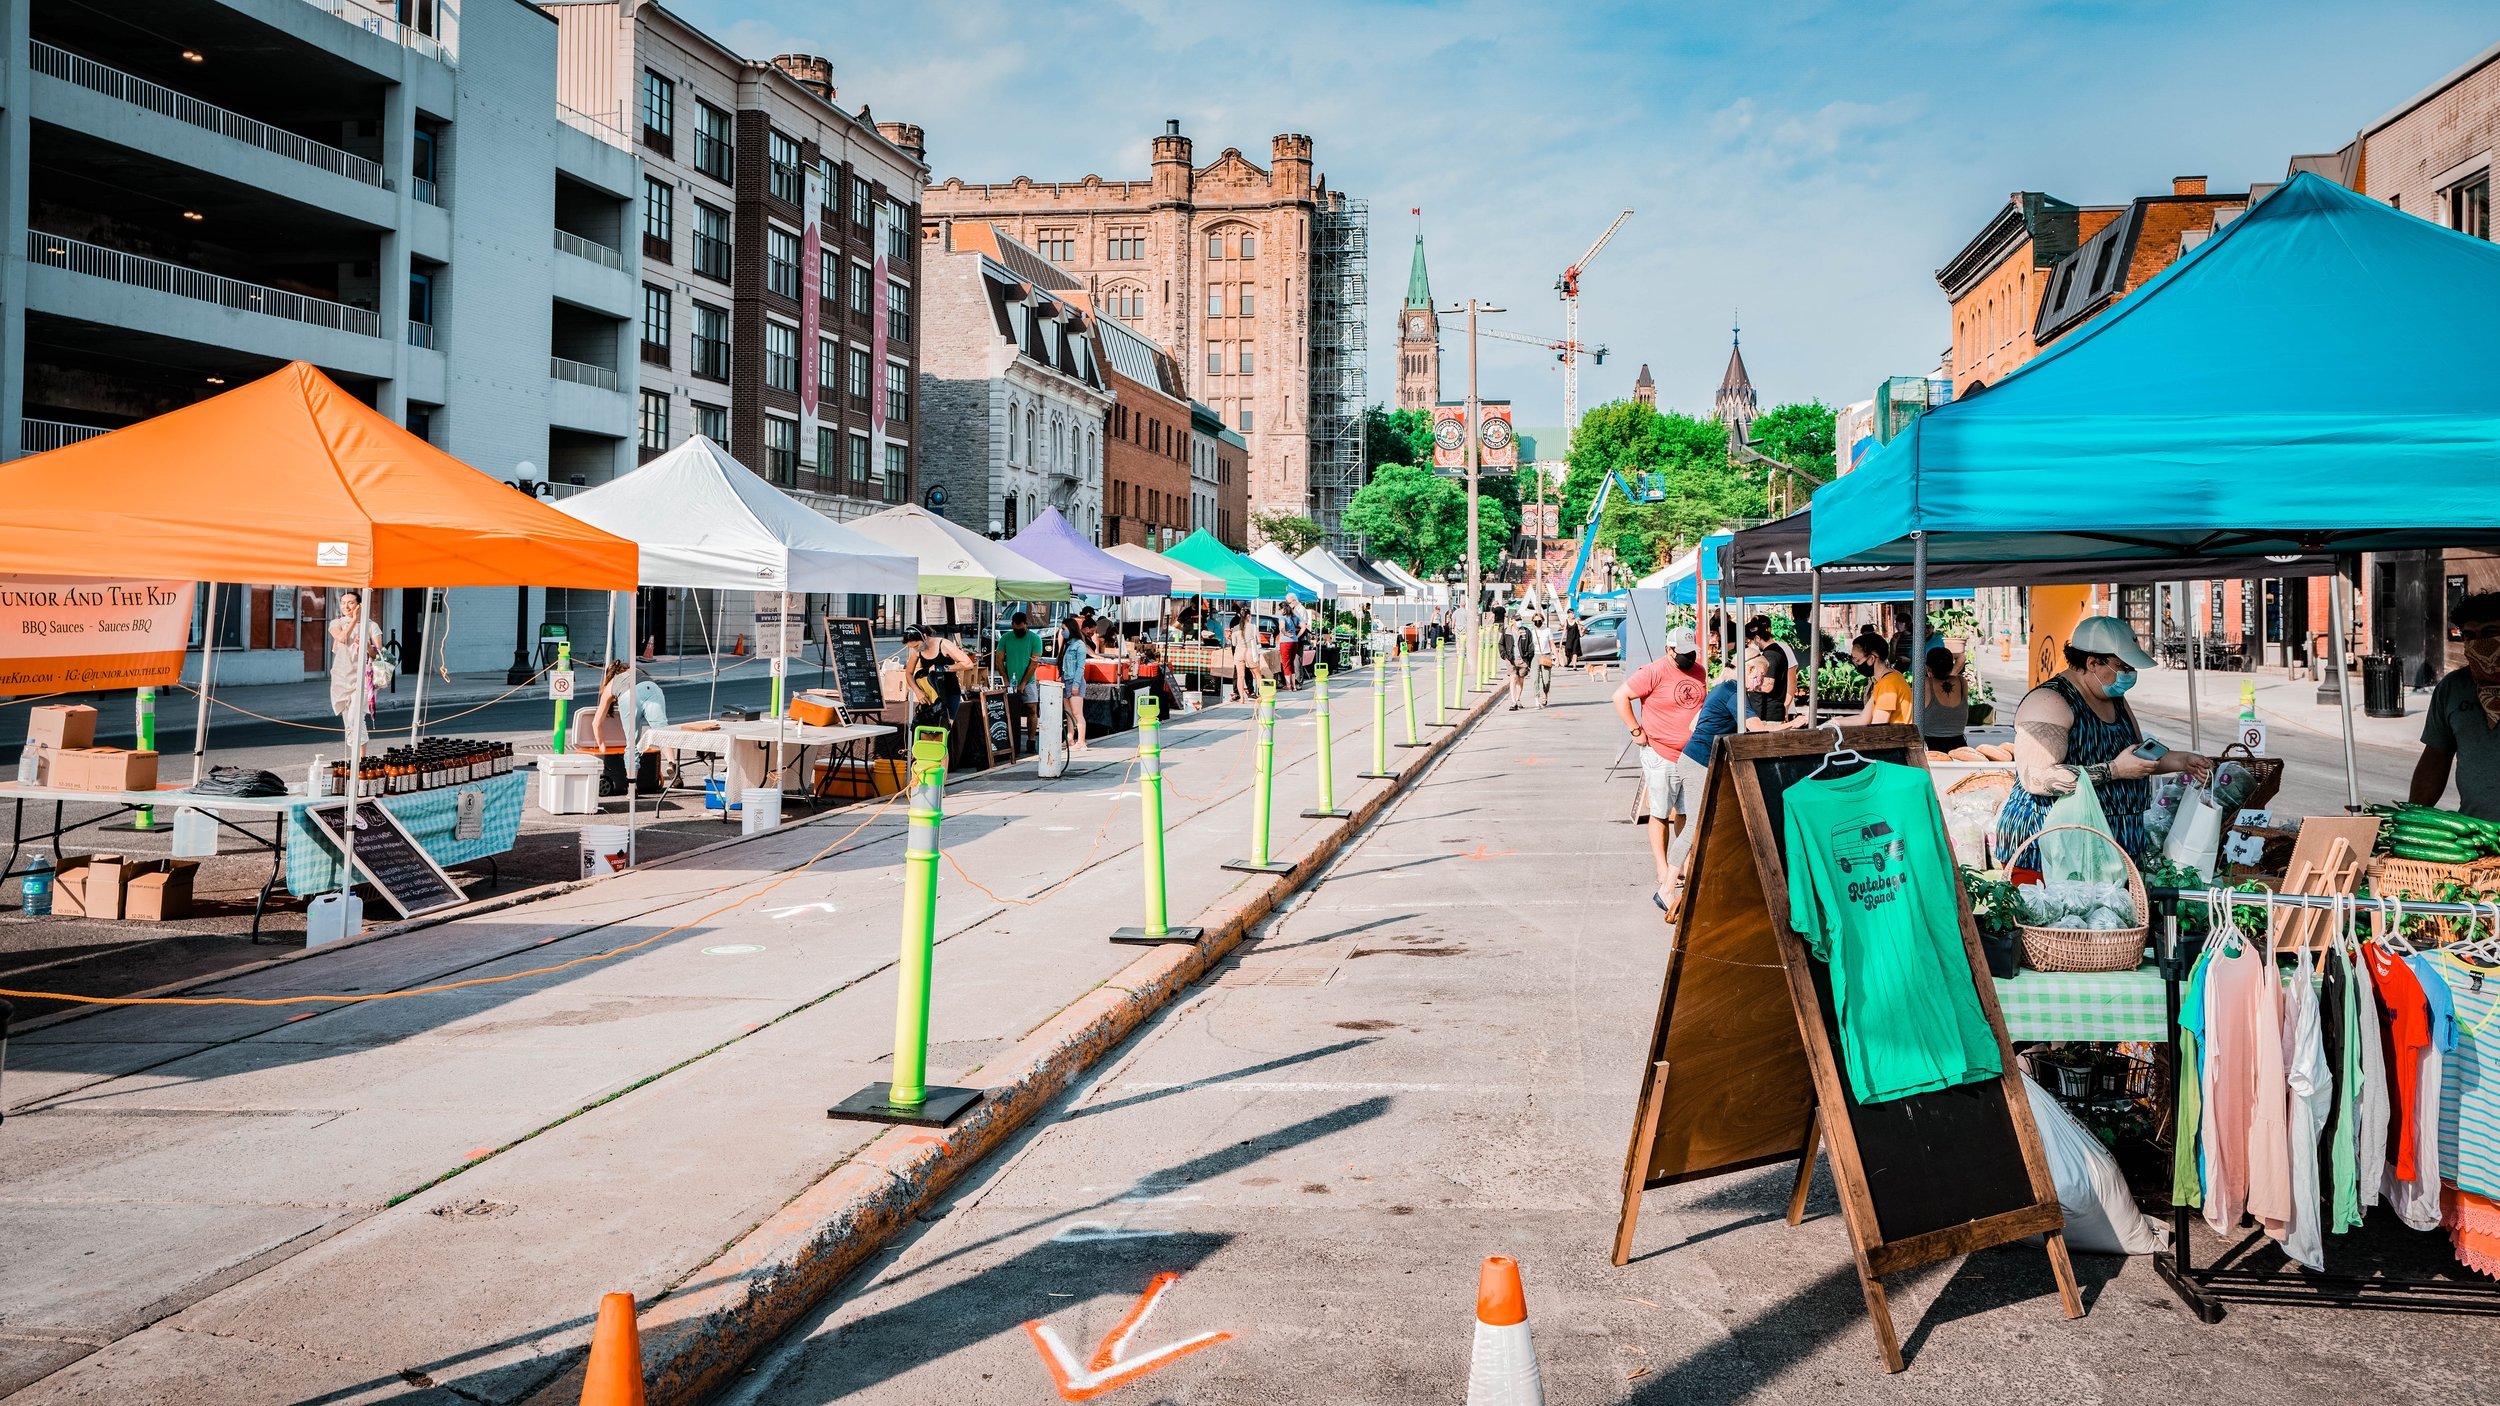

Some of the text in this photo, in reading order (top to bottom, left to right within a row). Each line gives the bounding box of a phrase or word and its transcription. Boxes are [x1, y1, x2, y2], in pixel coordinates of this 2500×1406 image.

[22, 620, 48, 636] BBQ
[50, 620, 85, 634] Sauces
[98, 619, 131, 633] Sauces
[132, 619, 153, 634] BBQ
[1847, 871, 1907, 903] Rutabaga
[1863, 889, 1897, 911] Ranch
